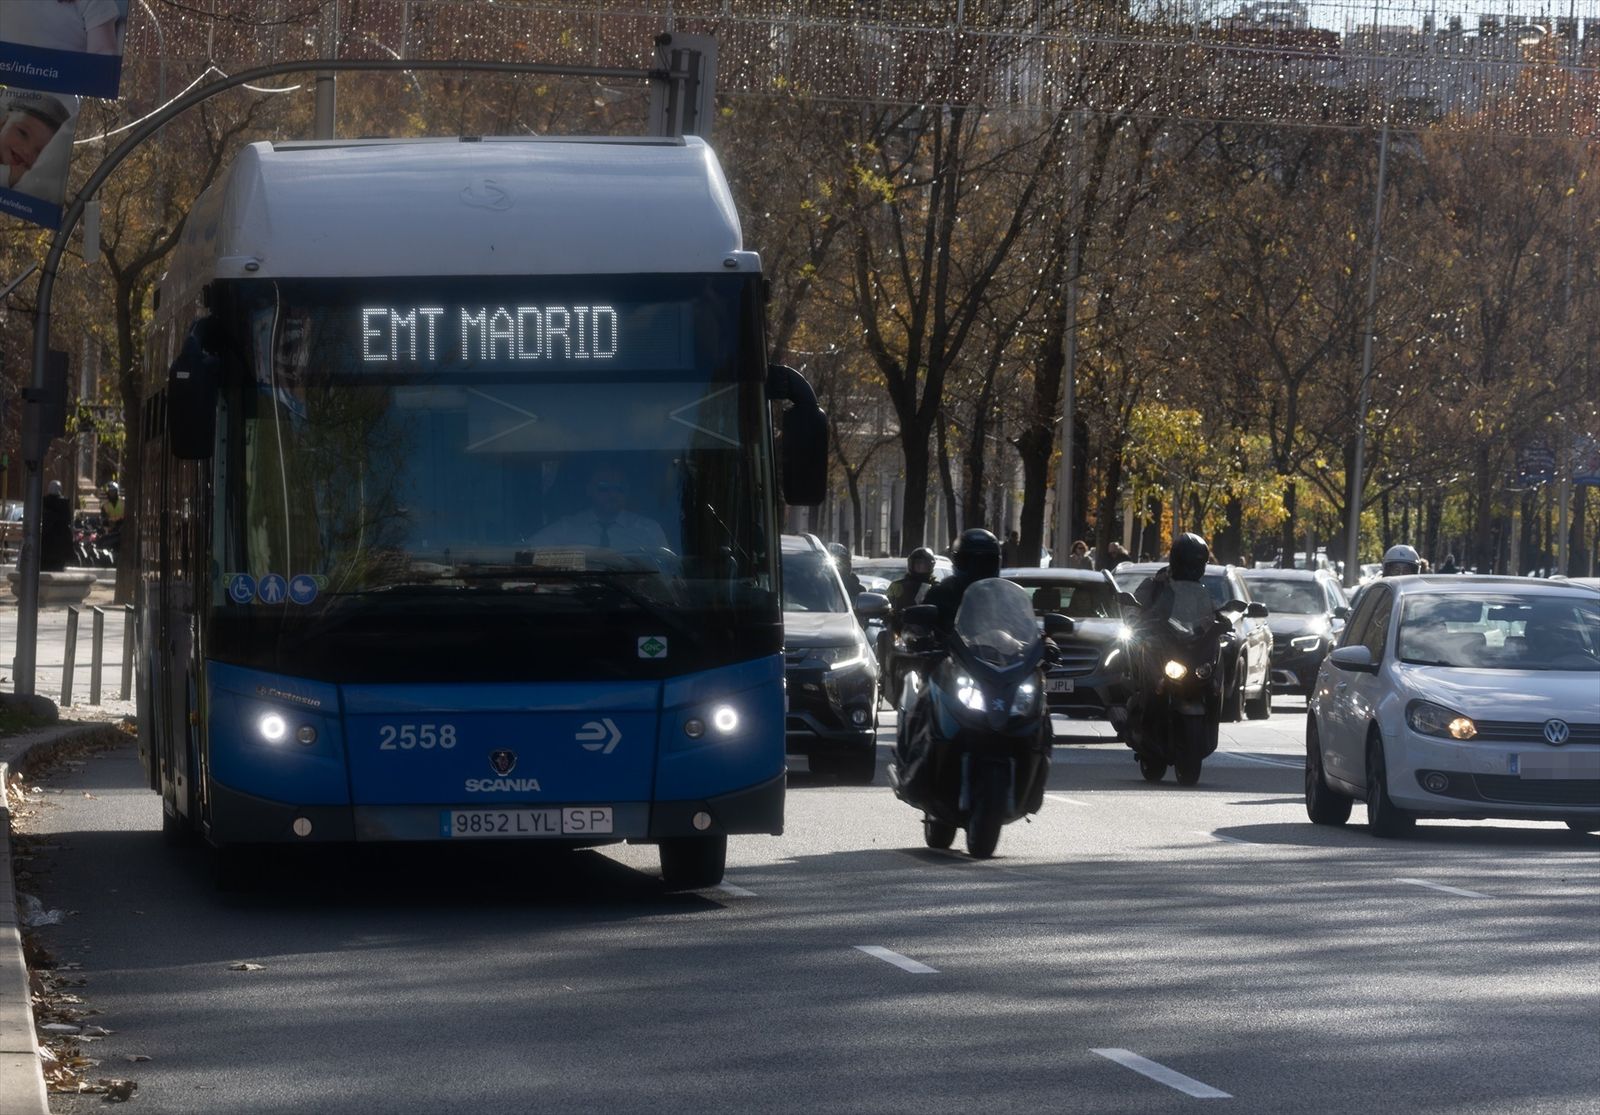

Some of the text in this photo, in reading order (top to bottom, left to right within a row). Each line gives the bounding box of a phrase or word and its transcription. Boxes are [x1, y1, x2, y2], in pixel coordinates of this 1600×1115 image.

[363, 305, 617, 361] EMT MADRID
[1051, 681, 1071, 691] JPL
[379, 724, 457, 750] 2558
[465, 778, 541, 792] SCANIA
[456, 813, 556, 833] 9852 LYL
[570, 810, 605, 831] SP
